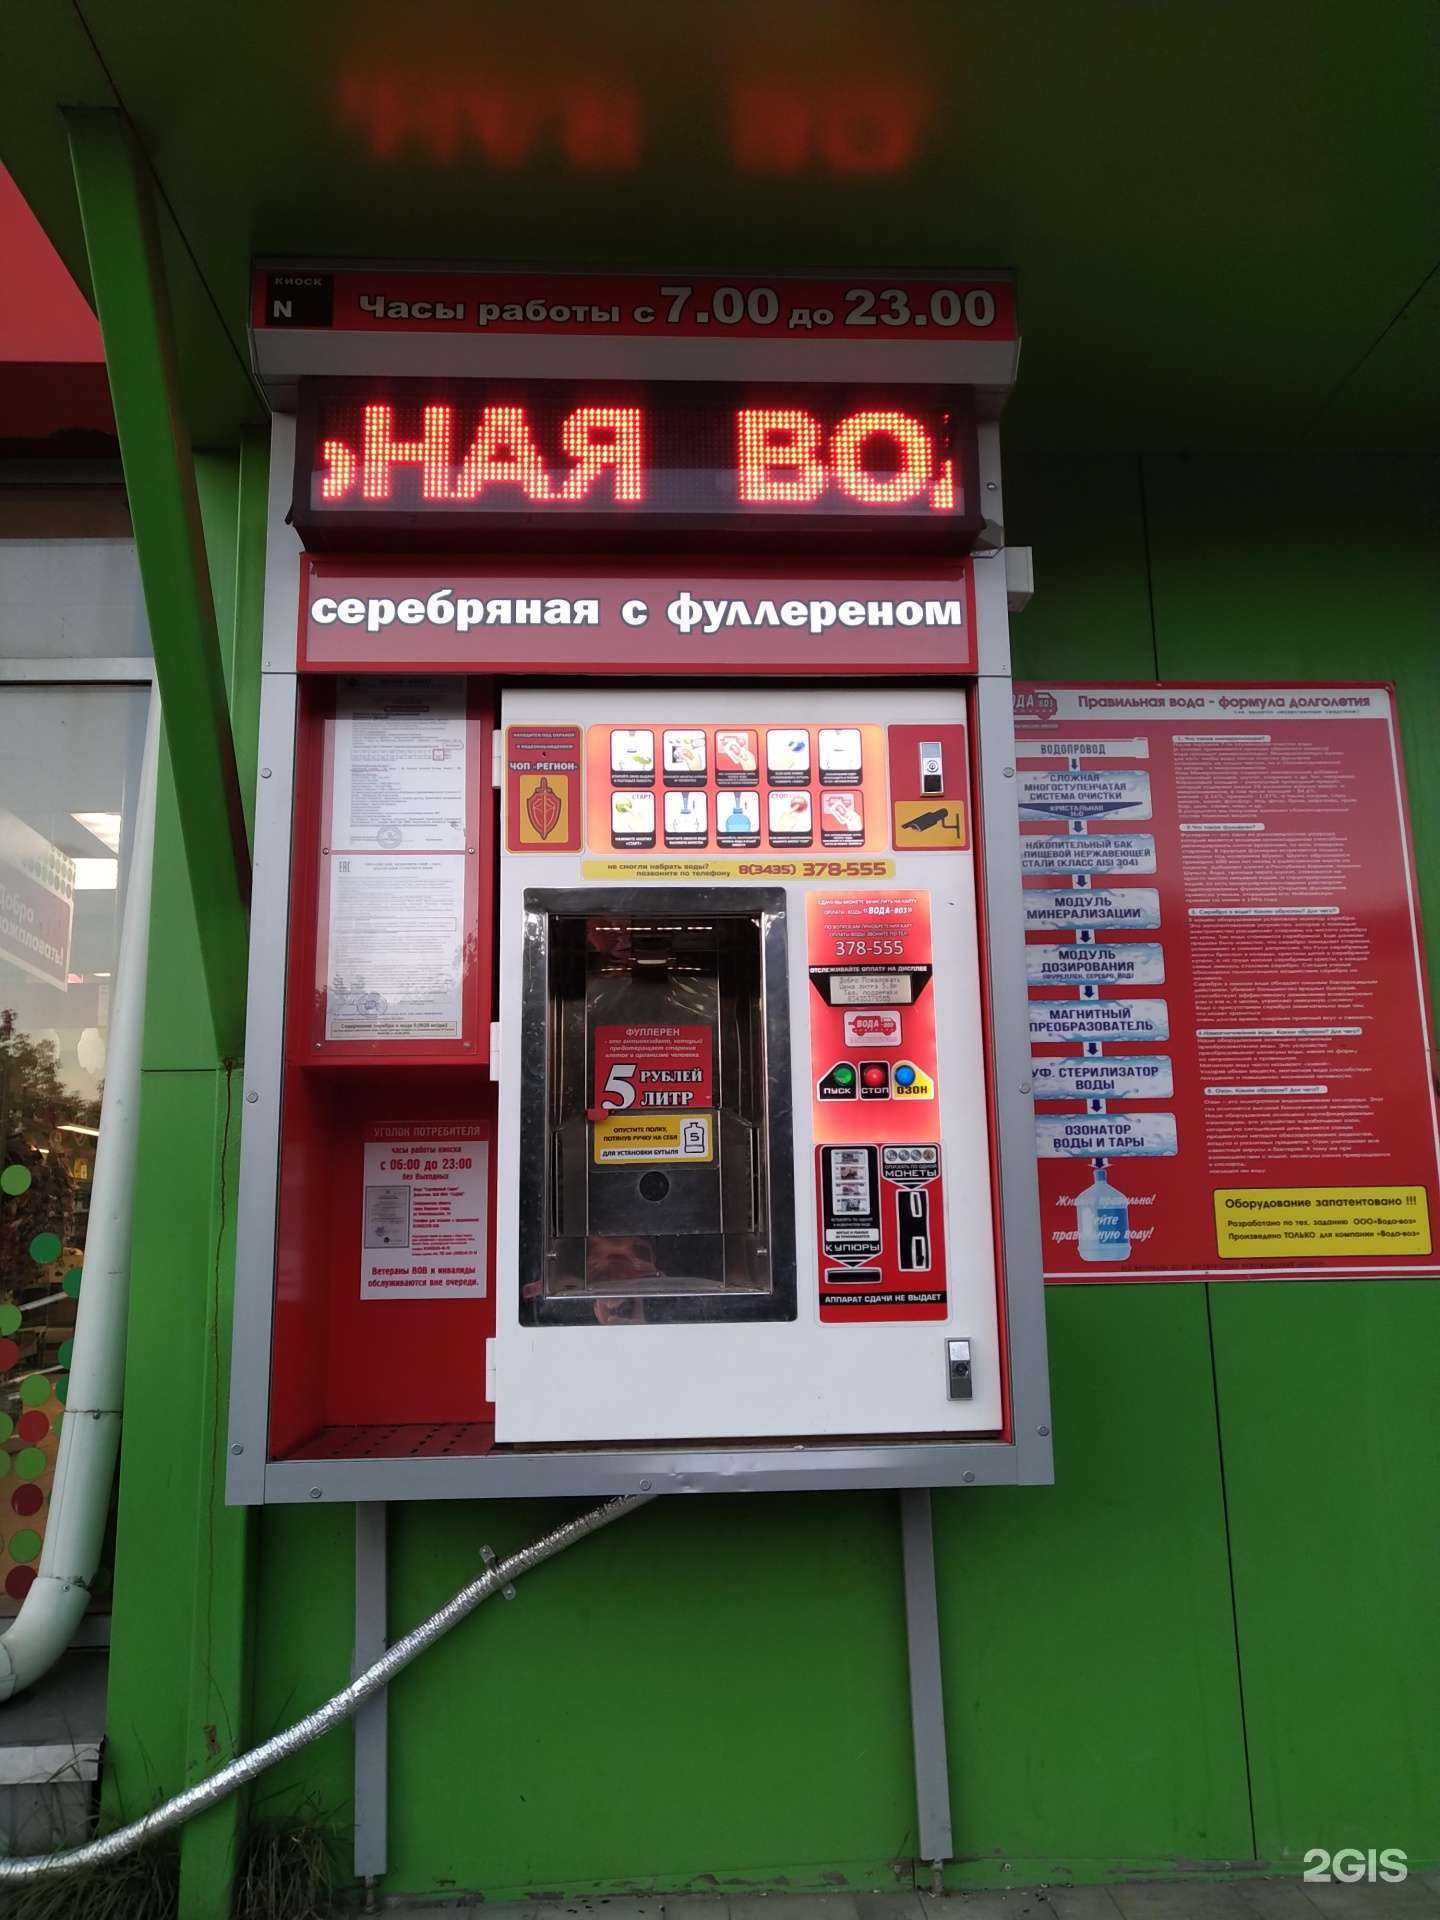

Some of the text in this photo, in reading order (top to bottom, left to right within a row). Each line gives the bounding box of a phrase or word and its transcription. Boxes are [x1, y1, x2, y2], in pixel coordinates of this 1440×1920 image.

[359, 286, 996, 329] Часы работы с 7.00 до 23.00
[736, 409, 955, 510] ВО
[310, 589, 962, 633] серебряная с фуллереном
[1078, 695, 1371, 709] Правильная вода формула долголетия
[1040, 744, 1106, 755] ВОДОПРОВОД
[509, 762, 530, 771] ЧОП
[1050, 774, 1100, 782] СЛОЖНАЯ
[1024, 783, 1127, 791] МНОГОСТУПЕНЧАТАЯ
[1030, 792, 1122, 801] СИСТЕМА ОЧИСТКИ
[1025, 840, 1133, 849] НАКОПИТЕЛЬНЫЙ БАК
[1024, 849, 1151, 859] ПИЩЕВОЙ НЕРЖАВЕЮЩЕЙ
[1022, 859, 1055, 868] СТАЛИ
[738, 862, 887, 877] 8(3435) 378-555
[1054, 897, 1112, 907] МОДУЛЬ
[1026, 908, 1141, 920] МИНЕРАЛИЗАЦИИ
[835, 940, 904, 956] 378-555
[1058, 950, 1116, 960] МОДУЛЬ
[1041, 961, 1135, 973] ДОЗИРОВАНИЯ
[1049, 1007, 1131, 1020] МАГНИТНЫЙ
[1029, 1020, 1153, 1032] ПРЕОБРАЗОВАТЕЛЬ
[625, 1028, 681, 1037] ФУЛЛЕРЕН
[639, 1068, 703, 1083] РУБЛЕЙ
[1058, 1066, 1159, 1077] СТЕРИЛИЗАТОР
[601, 1064, 638, 1110] 5
[823, 1086, 852, 1095] ПУСК
[861, 1086, 889, 1095] СТОП
[896, 1085, 928, 1095] ОЗОН
[1075, 1079, 1115, 1091] ВОДЫ
[640, 1091, 694, 1106] ЛИТР
[373, 1126, 480, 1137] УГОЛОК ПОТРЕБИТЕЛЯ
[1064, 1124, 1132, 1136] ОЗОНАТОР
[690, 1132, 700, 1142] 5
[1053, 1136, 1145, 1149] ВОДЫ И ТАРЫ
[424, 1160, 438, 1171] до
[442, 1158, 472, 1169] 23:00
[1225, 1195, 1417, 1210] Оборудование запатентовано !!!
[1284, 1231, 1316, 1239] ТОЛЬКО
[825, 1243, 880, 1252] КУПЮРЫ
[907, 1293, 942, 1302] ВЫДАЕТ
